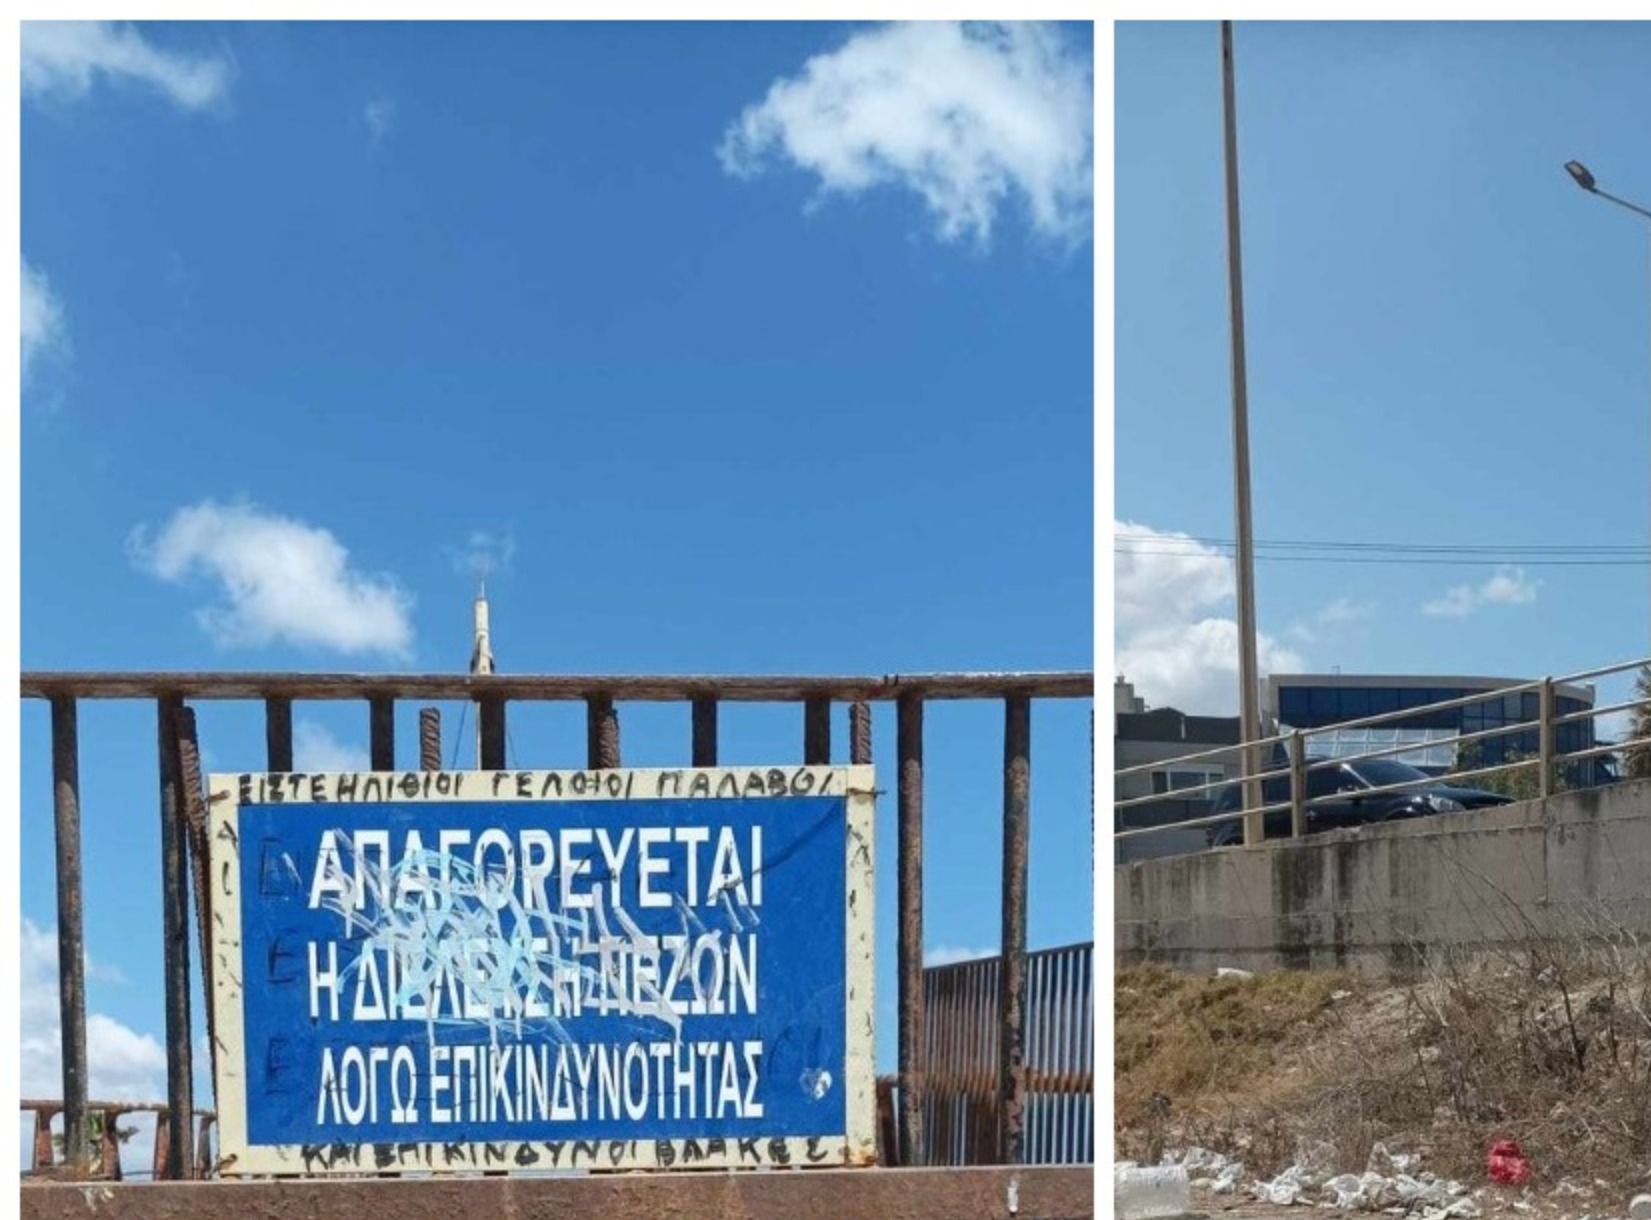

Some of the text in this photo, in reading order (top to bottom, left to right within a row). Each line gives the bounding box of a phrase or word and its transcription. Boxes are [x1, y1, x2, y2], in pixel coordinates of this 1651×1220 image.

[308, 942, 340, 1020] Η
[317, 1041, 764, 1126] ΛΟΓΩ ΕΠΙΚΙΝΔΥΝΟΤΗΤΑΣ
